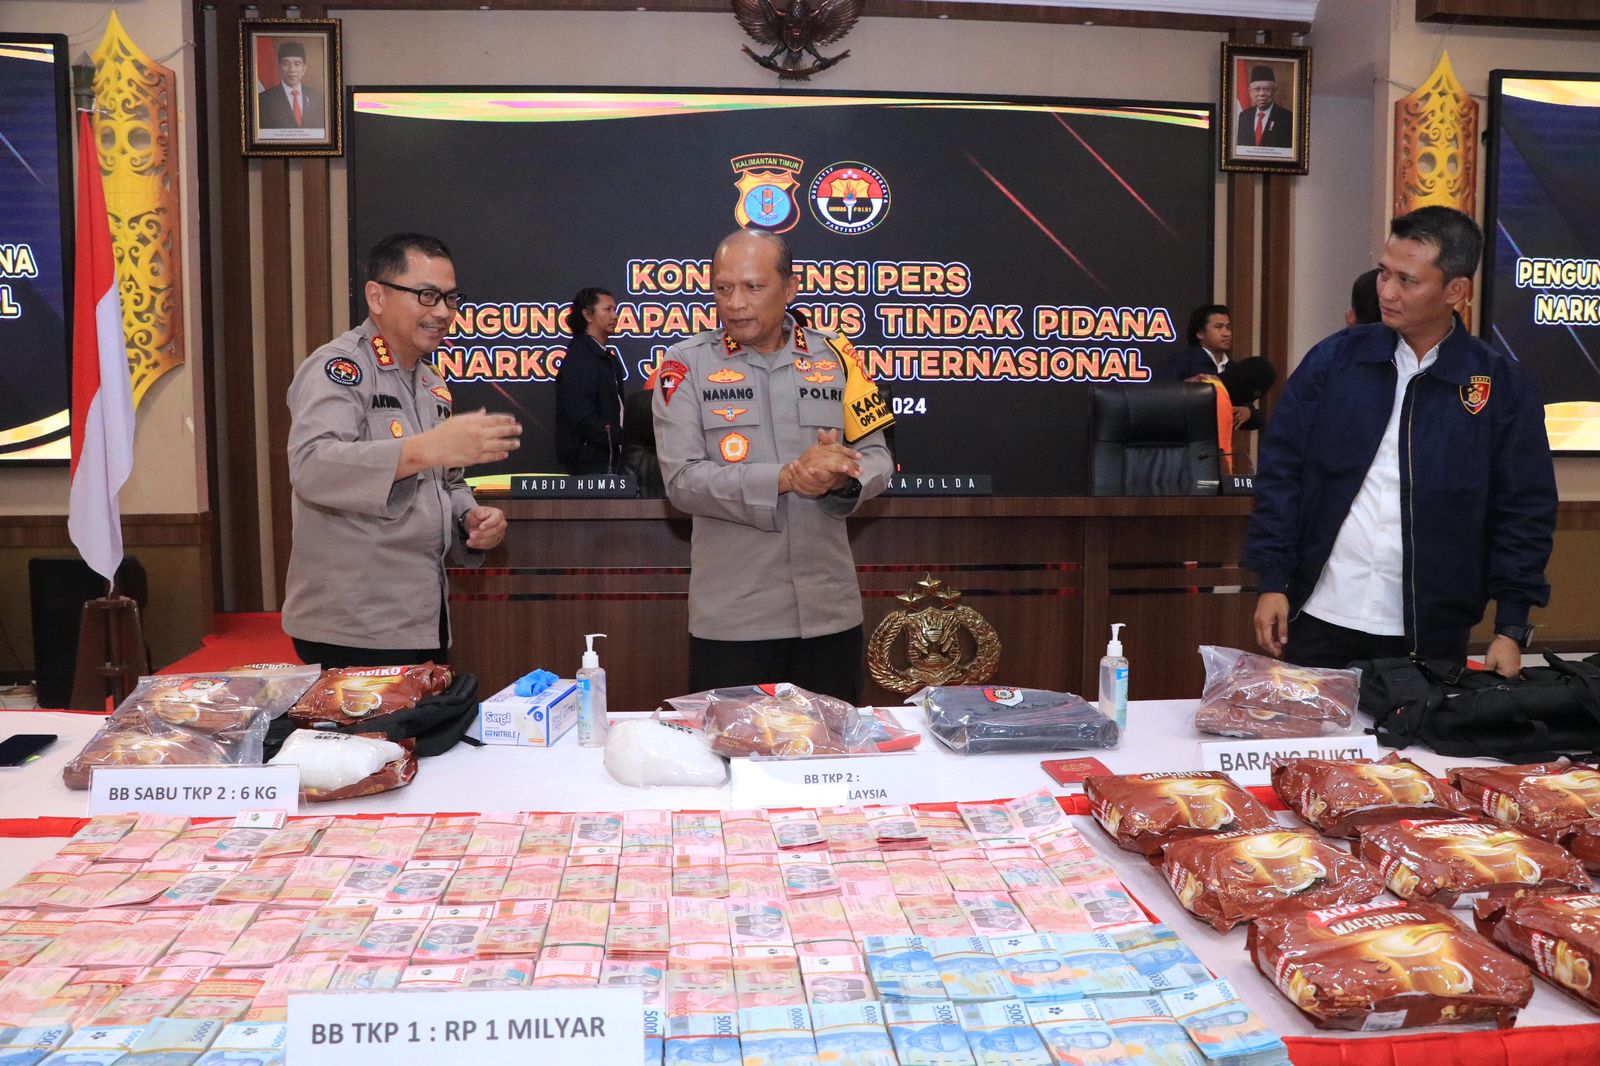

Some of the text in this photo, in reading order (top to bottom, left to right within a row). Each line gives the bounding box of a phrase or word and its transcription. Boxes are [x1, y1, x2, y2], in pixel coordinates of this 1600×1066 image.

[736, 157, 799, 169] KALIMANTAN TIMUR
[631, 263, 968, 293] KONENSI PERS
[1536, 297, 1600, 322] NARK
[879, 307, 1021, 336] TINDAK
[1037, 308, 1173, 338] PIDANA
[703, 388, 754, 401] NANANG
[800, 387, 842, 401] POLRI
[891, 397, 927, 414] 024
[860, 412, 877, 427] OPS
[521, 479, 626, 490] KABID HUMAS
[887, 478, 975, 489] KAPOLDA
[484, 711, 512, 726] Sensi
[493, 730, 518, 739] NITRILE
[804, 774, 819, 784] BB
[822, 773, 843, 784] TKP
[846, 773, 853, 783] 2
[108, 787, 130, 801] BB
[133, 786, 178, 800] SABU
[182, 787, 212, 800] TKP
[217, 786, 226, 800] 2
[240, 785, 250, 799] 6
[255, 786, 277, 800] KG
[312, 1023, 344, 1044] BB
[352, 1021, 399, 1044] TKP
[407, 1021, 420, 1042] 1
[445, 1020, 477, 1041] RP
[485, 1019, 499, 1040] 1
[508, 1016, 606, 1040] MILYAR
